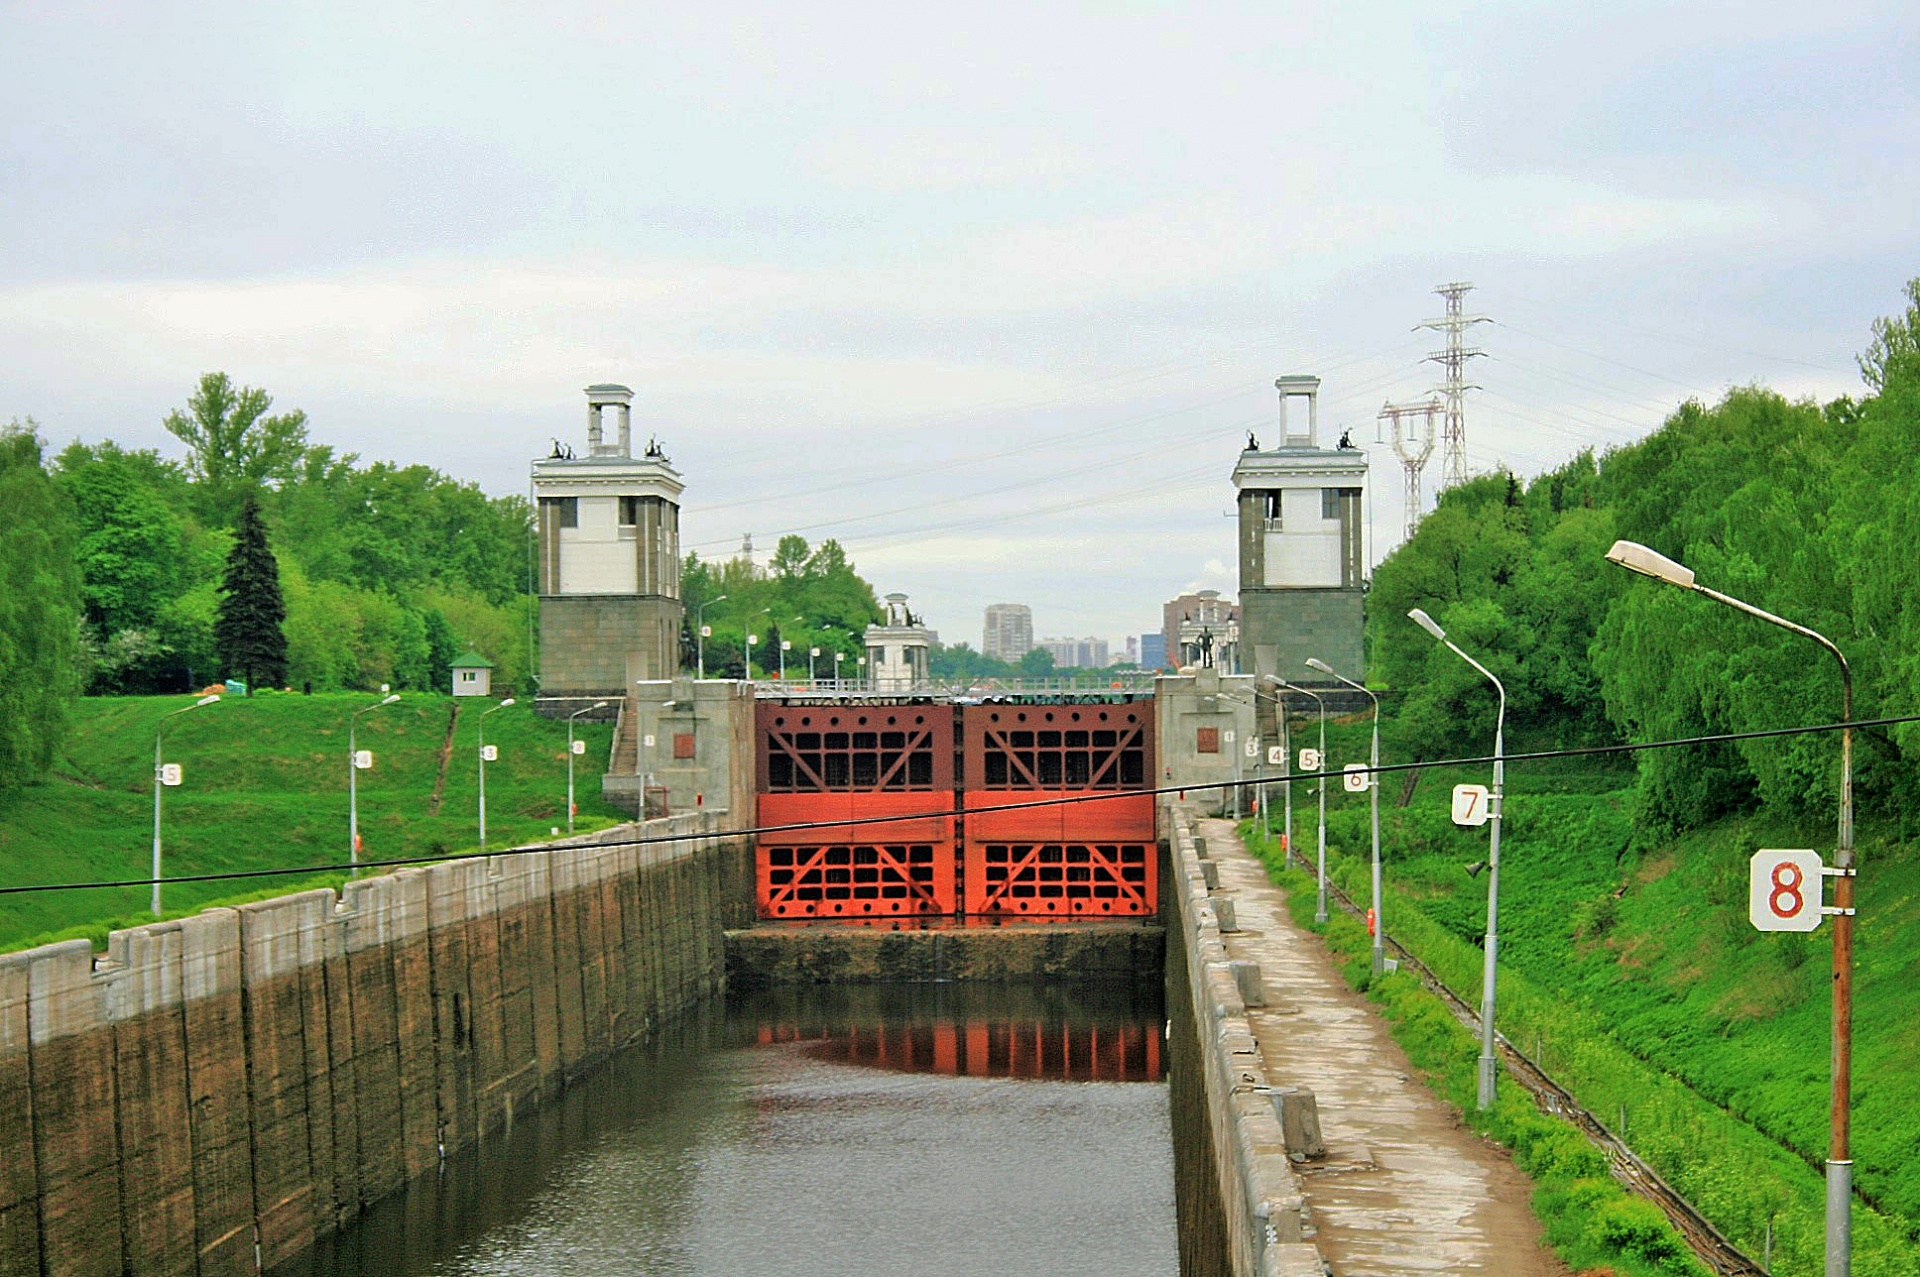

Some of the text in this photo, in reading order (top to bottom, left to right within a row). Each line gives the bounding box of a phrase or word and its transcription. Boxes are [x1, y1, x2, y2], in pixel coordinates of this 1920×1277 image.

[1248, 743, 1255, 755] 3
[1272, 750, 1281, 761] 4
[1304, 752, 1314, 766] 5
[168, 767, 176, 780] 5
[1350, 771, 1362, 787] 6
[1461, 791, 1479, 819] 7
[1768, 860, 1804, 919] 8
